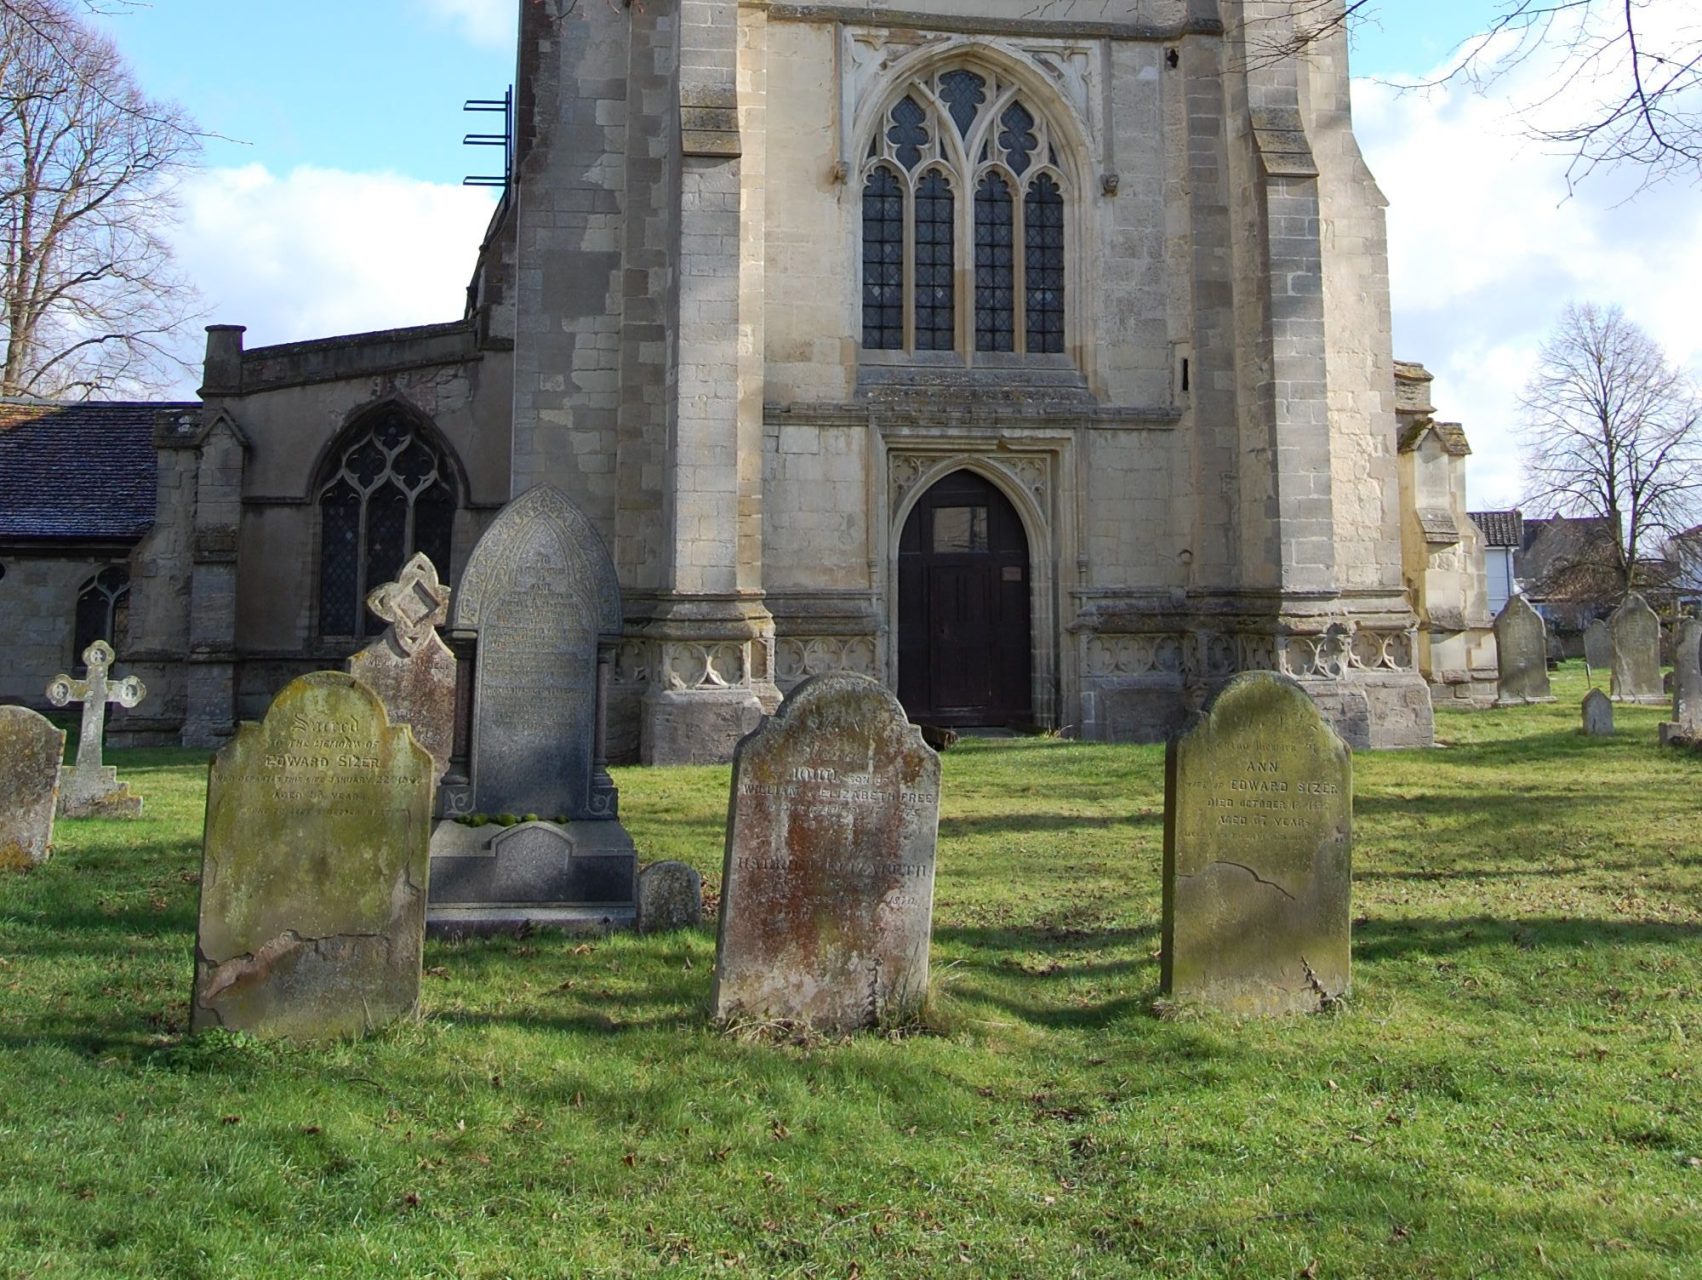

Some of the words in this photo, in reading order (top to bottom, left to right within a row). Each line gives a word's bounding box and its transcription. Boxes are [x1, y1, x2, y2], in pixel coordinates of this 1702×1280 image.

[290, 713, 359, 734] Sacred
[289, 739, 308, 749] THE
[364, 740, 380, 750] OF
[264, 754, 329, 768] EDWARD
[337, 755, 380, 769] SIZER
[1246, 761, 1279, 773] ANN
[328, 776, 371, 785] JANUARY
[849, 774, 871, 785] SON
[743, 784, 800, 797] WILLIAM
[819, 787, 896, 802] ELIZABETH
[1231, 779, 1289, 793] EDWARD
[1296, 782, 1338, 795] SIZER
[1207, 797, 1234, 808] DIED
[1239, 798, 1287, 810] OCTOBER
[1216, 815, 1247, 826] AGED
[1273, 816, 1312, 828] YEARS
